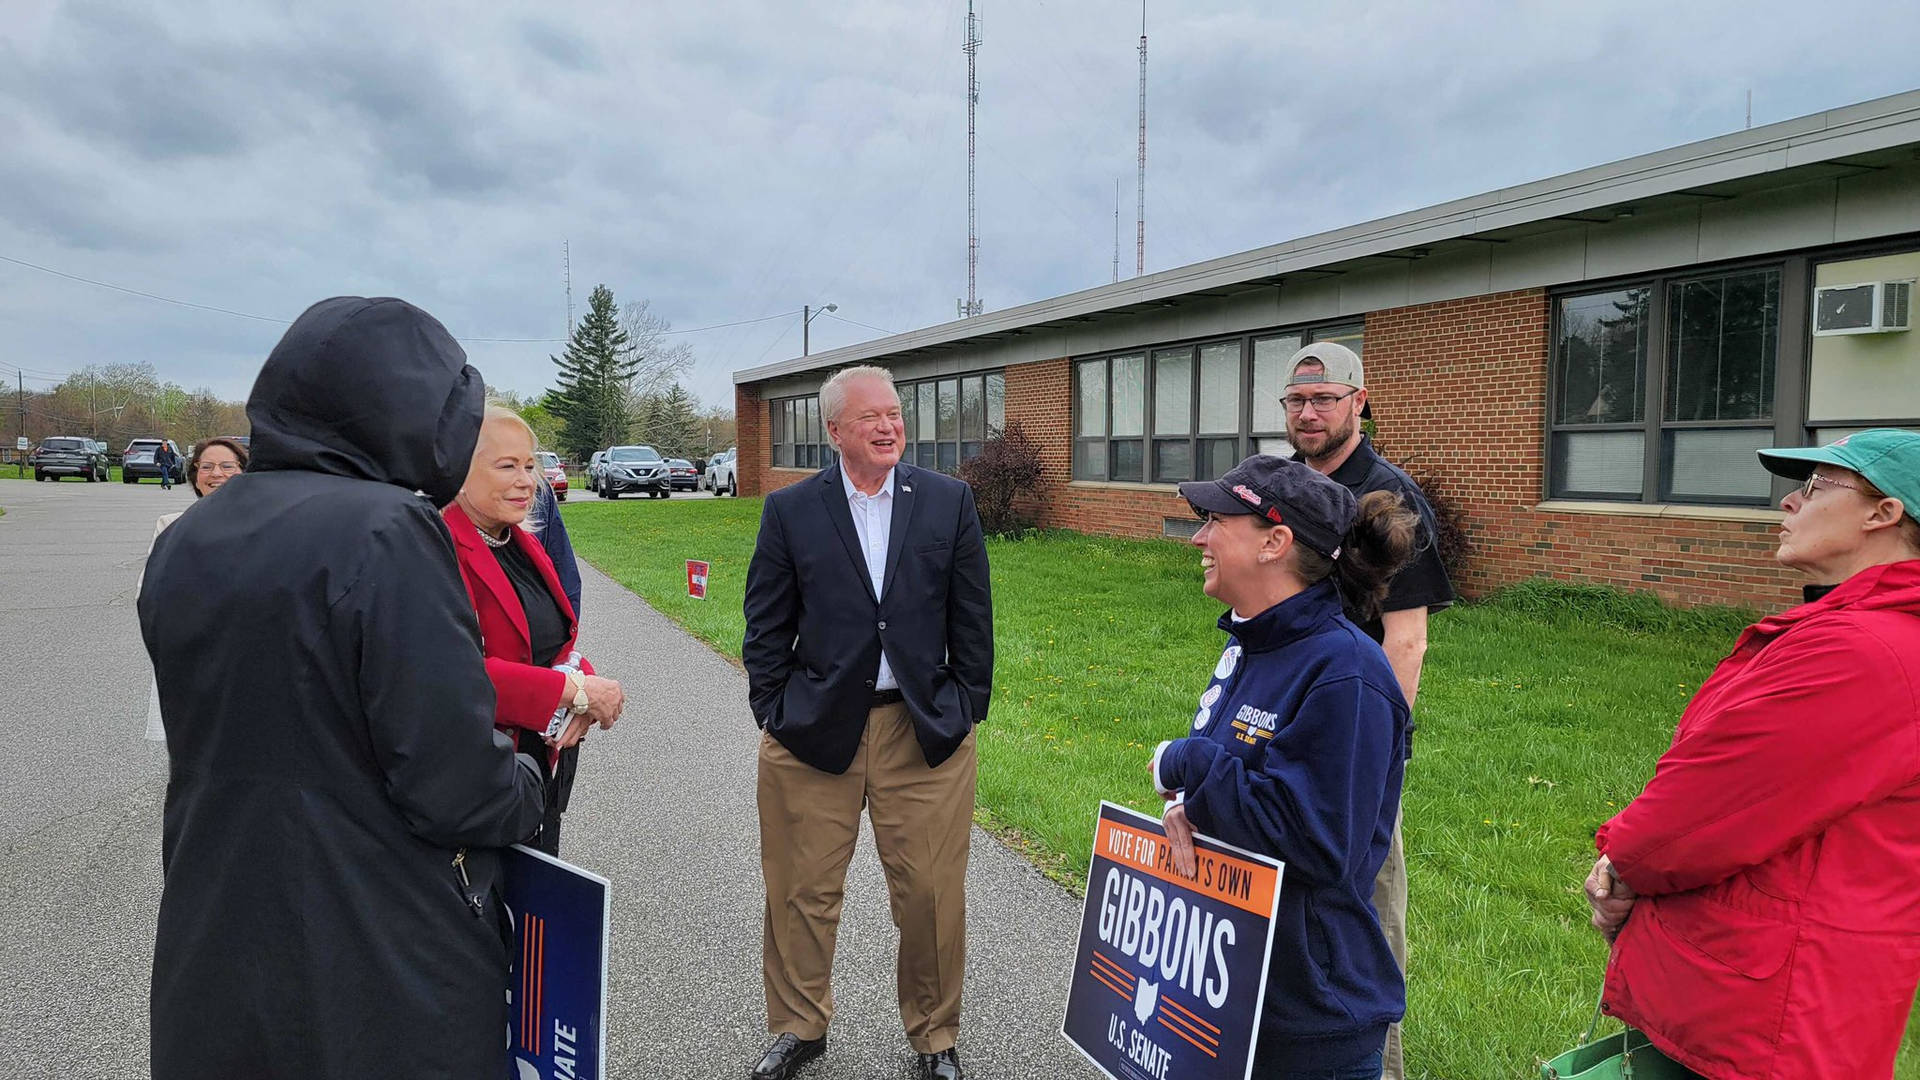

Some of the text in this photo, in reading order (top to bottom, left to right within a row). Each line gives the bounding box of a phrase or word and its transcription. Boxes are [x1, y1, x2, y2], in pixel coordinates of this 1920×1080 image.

[1236, 704, 1278, 731] GIBBONS
[1108, 828, 1253, 901] VOTE FOR PAA'S OWN
[1099, 867, 1236, 1009] GIBBONS
[554, 1018, 577, 1080] ATE
[1108, 1013, 1172, 1080] U.S. SENATE
